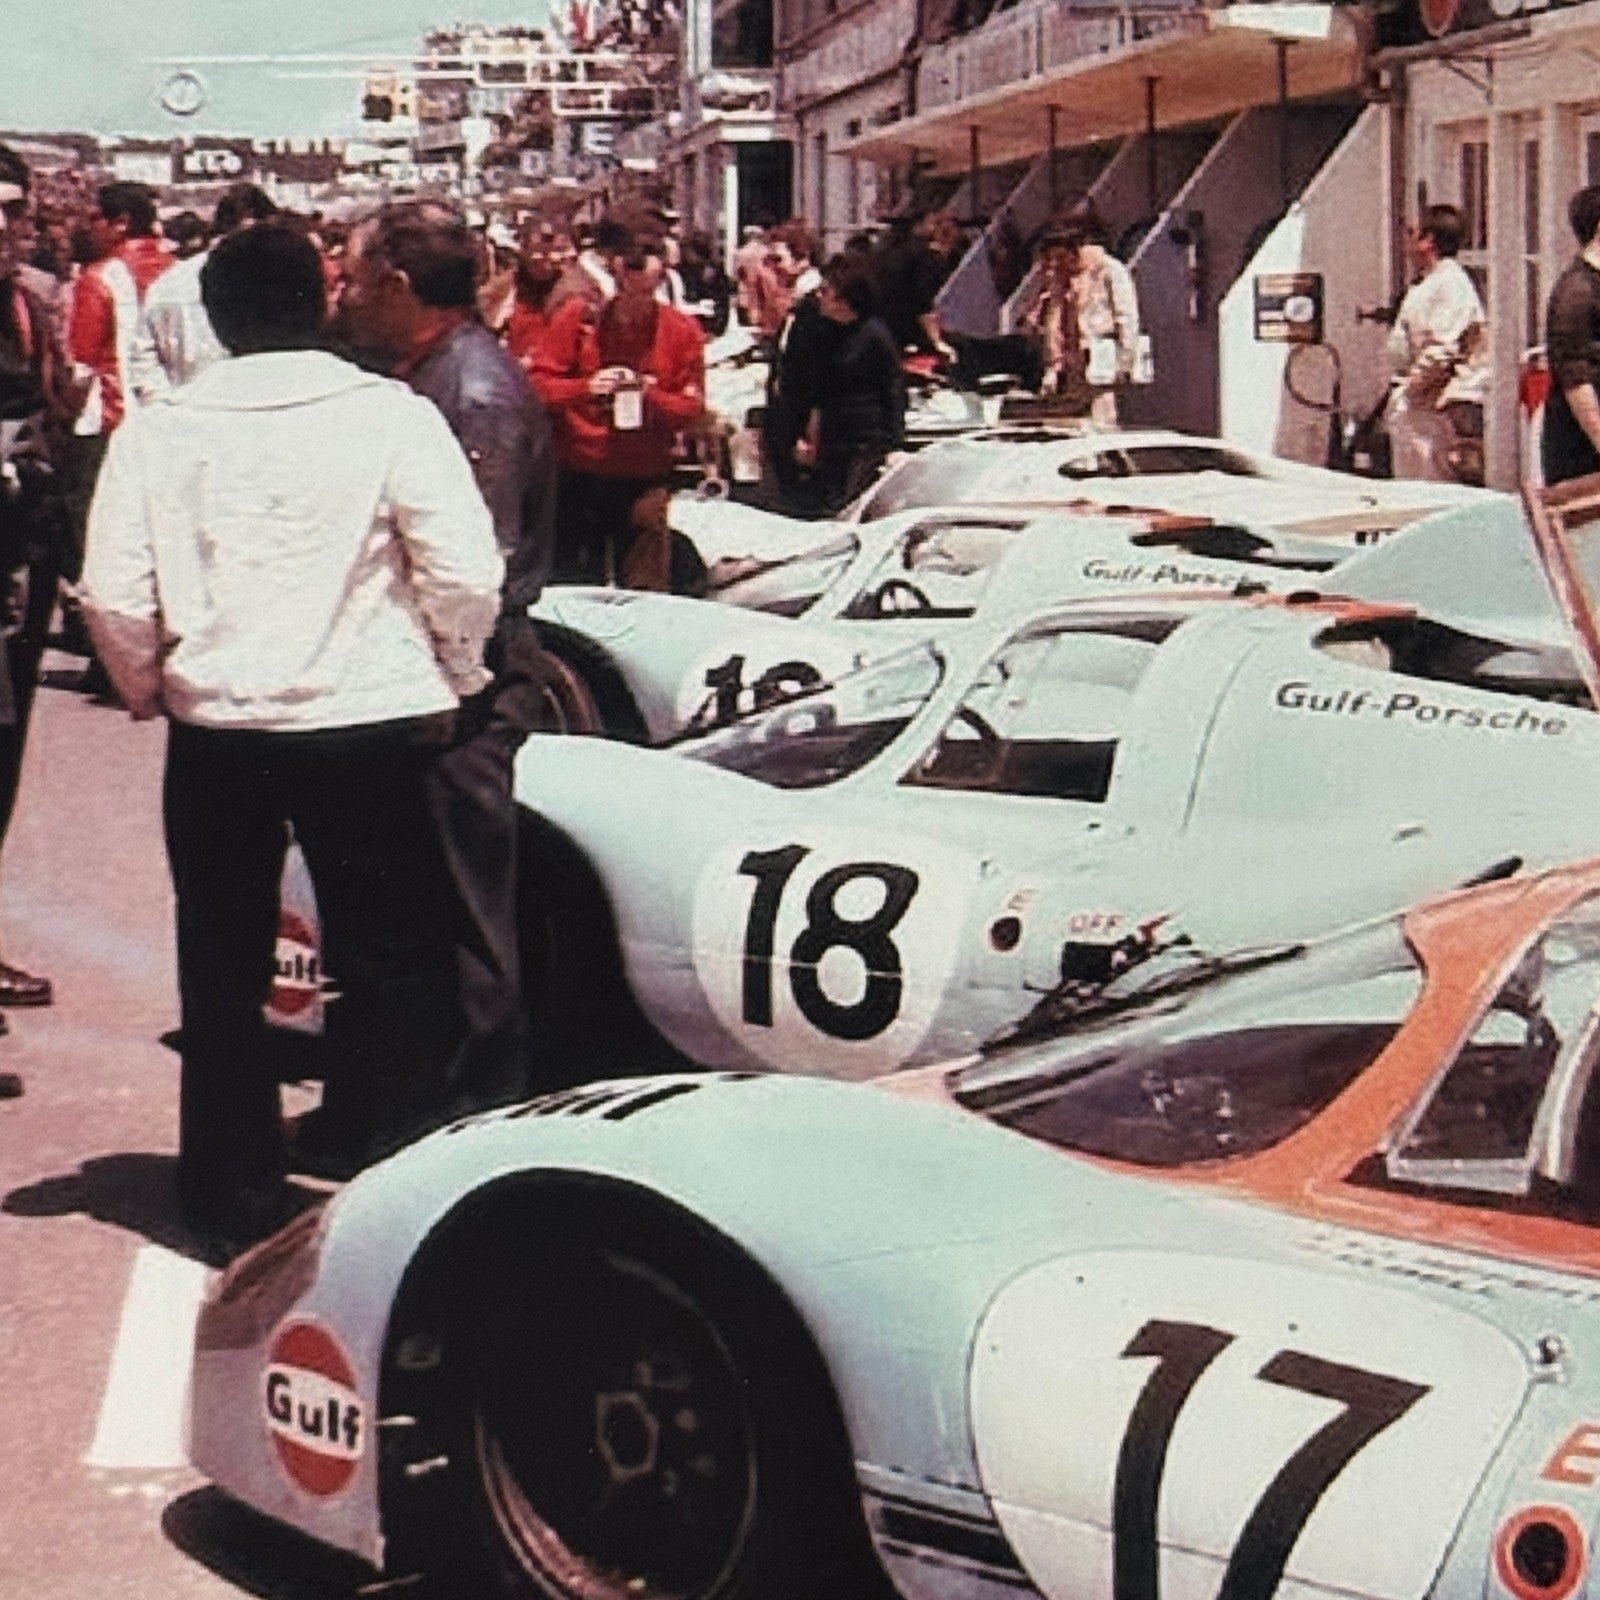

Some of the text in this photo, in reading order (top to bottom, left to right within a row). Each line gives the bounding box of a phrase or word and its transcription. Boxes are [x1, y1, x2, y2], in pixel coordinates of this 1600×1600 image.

[1083, 559, 1272, 592] Gulf-Porsc
[1276, 681, 1567, 736] Gulf-Porsche
[278, 953, 318, 984] ulf
[736, 843, 919, 1041] 18
[267, 1372, 360, 1450] Gulf
[1112, 1319, 1434, 1600] 17
